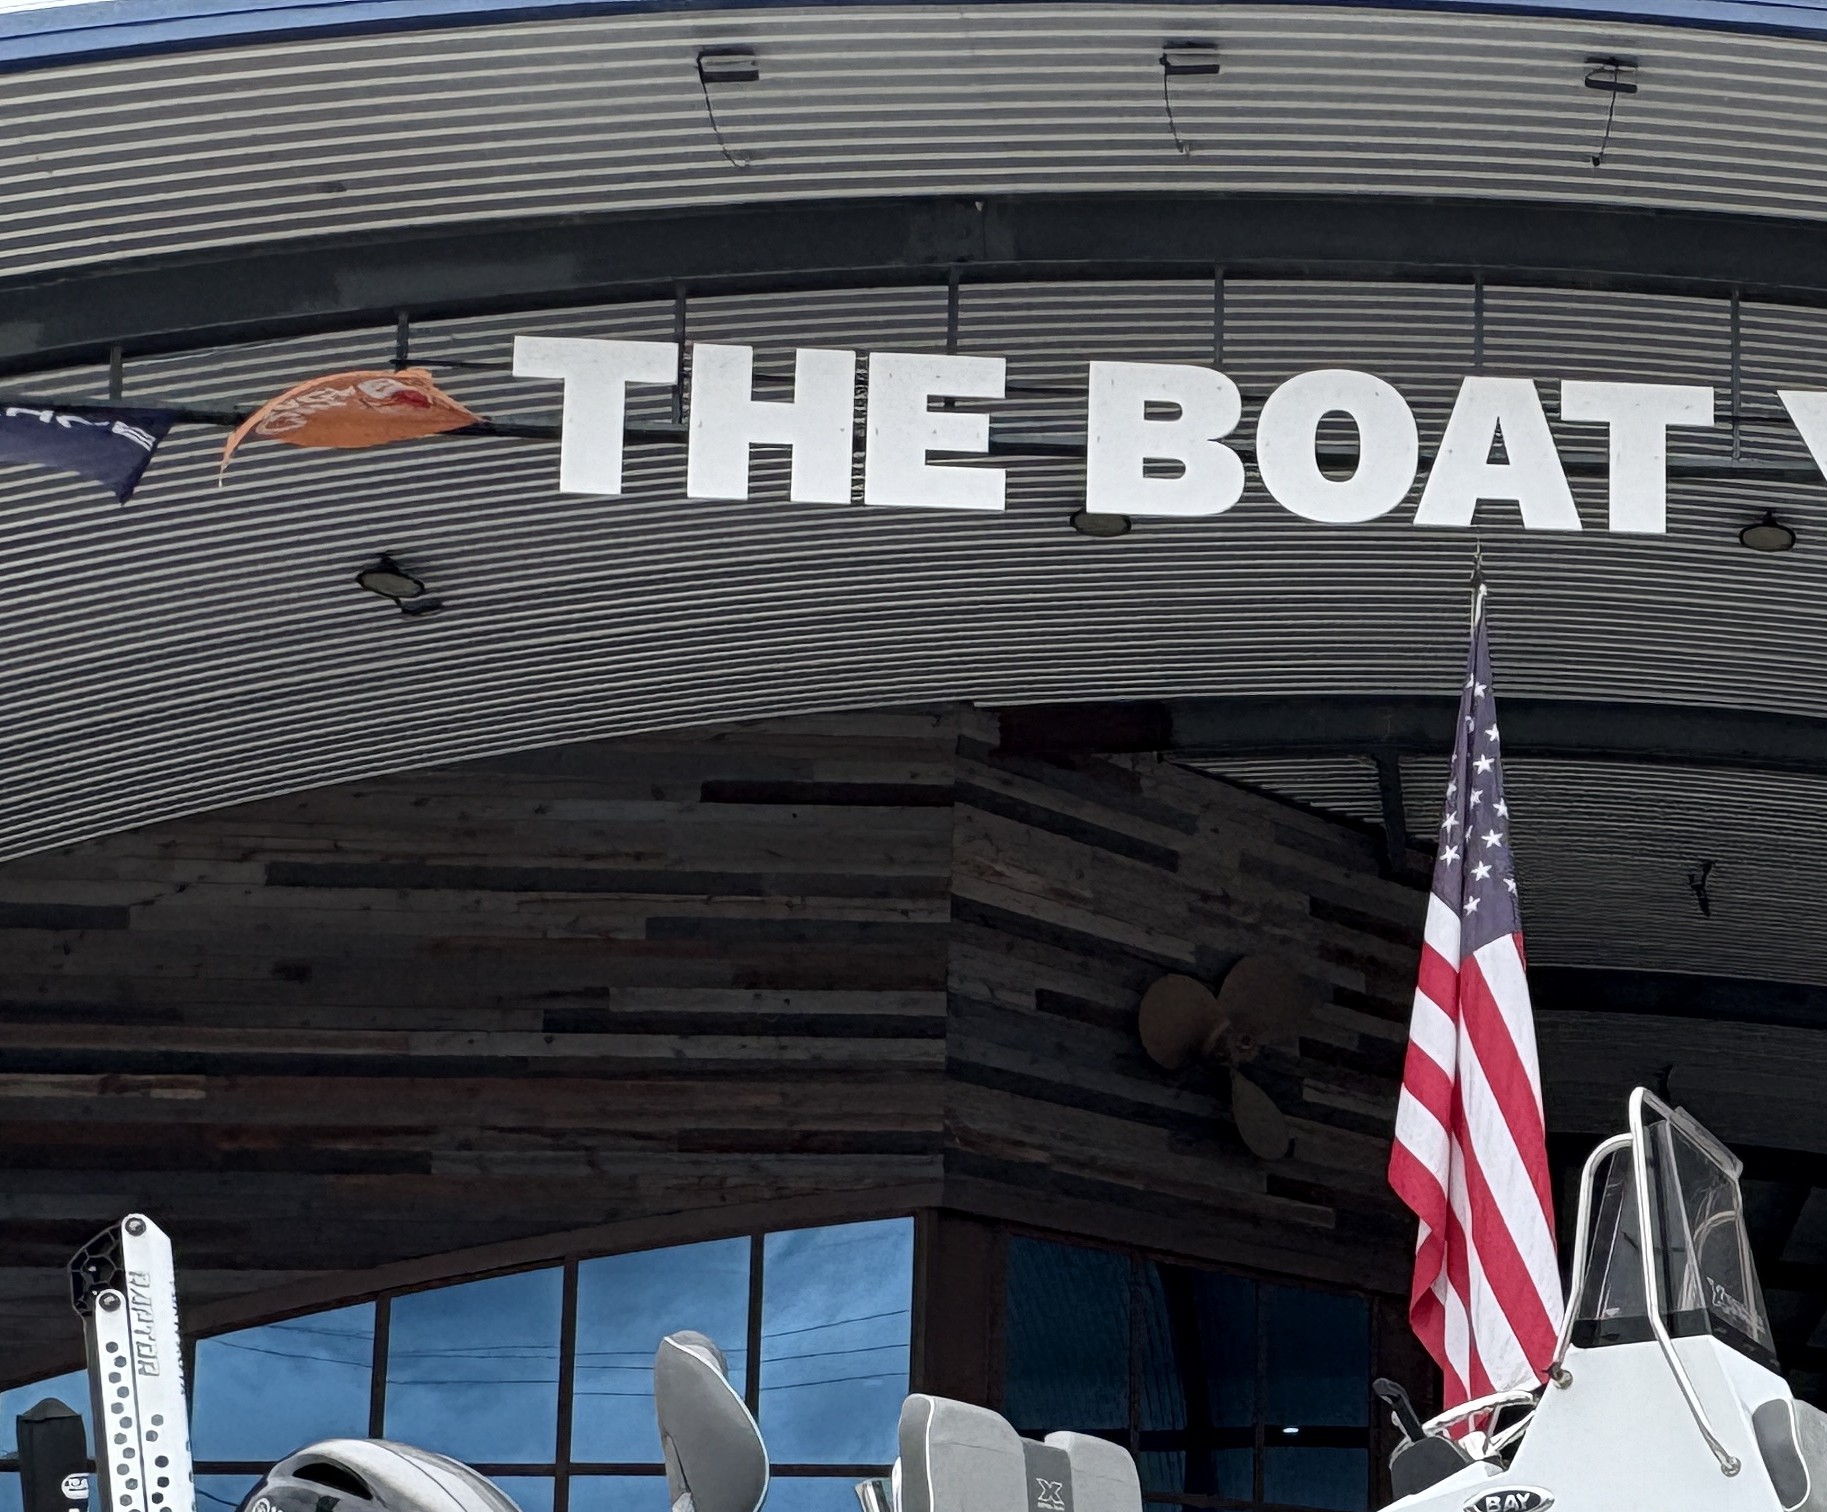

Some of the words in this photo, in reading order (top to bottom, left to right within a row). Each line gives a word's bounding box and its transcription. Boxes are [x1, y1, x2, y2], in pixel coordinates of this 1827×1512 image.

[512, 334, 1007, 512] THE
[1085, 359, 1715, 534] BOAT
[1486, 1492, 1531, 1512] BAY
